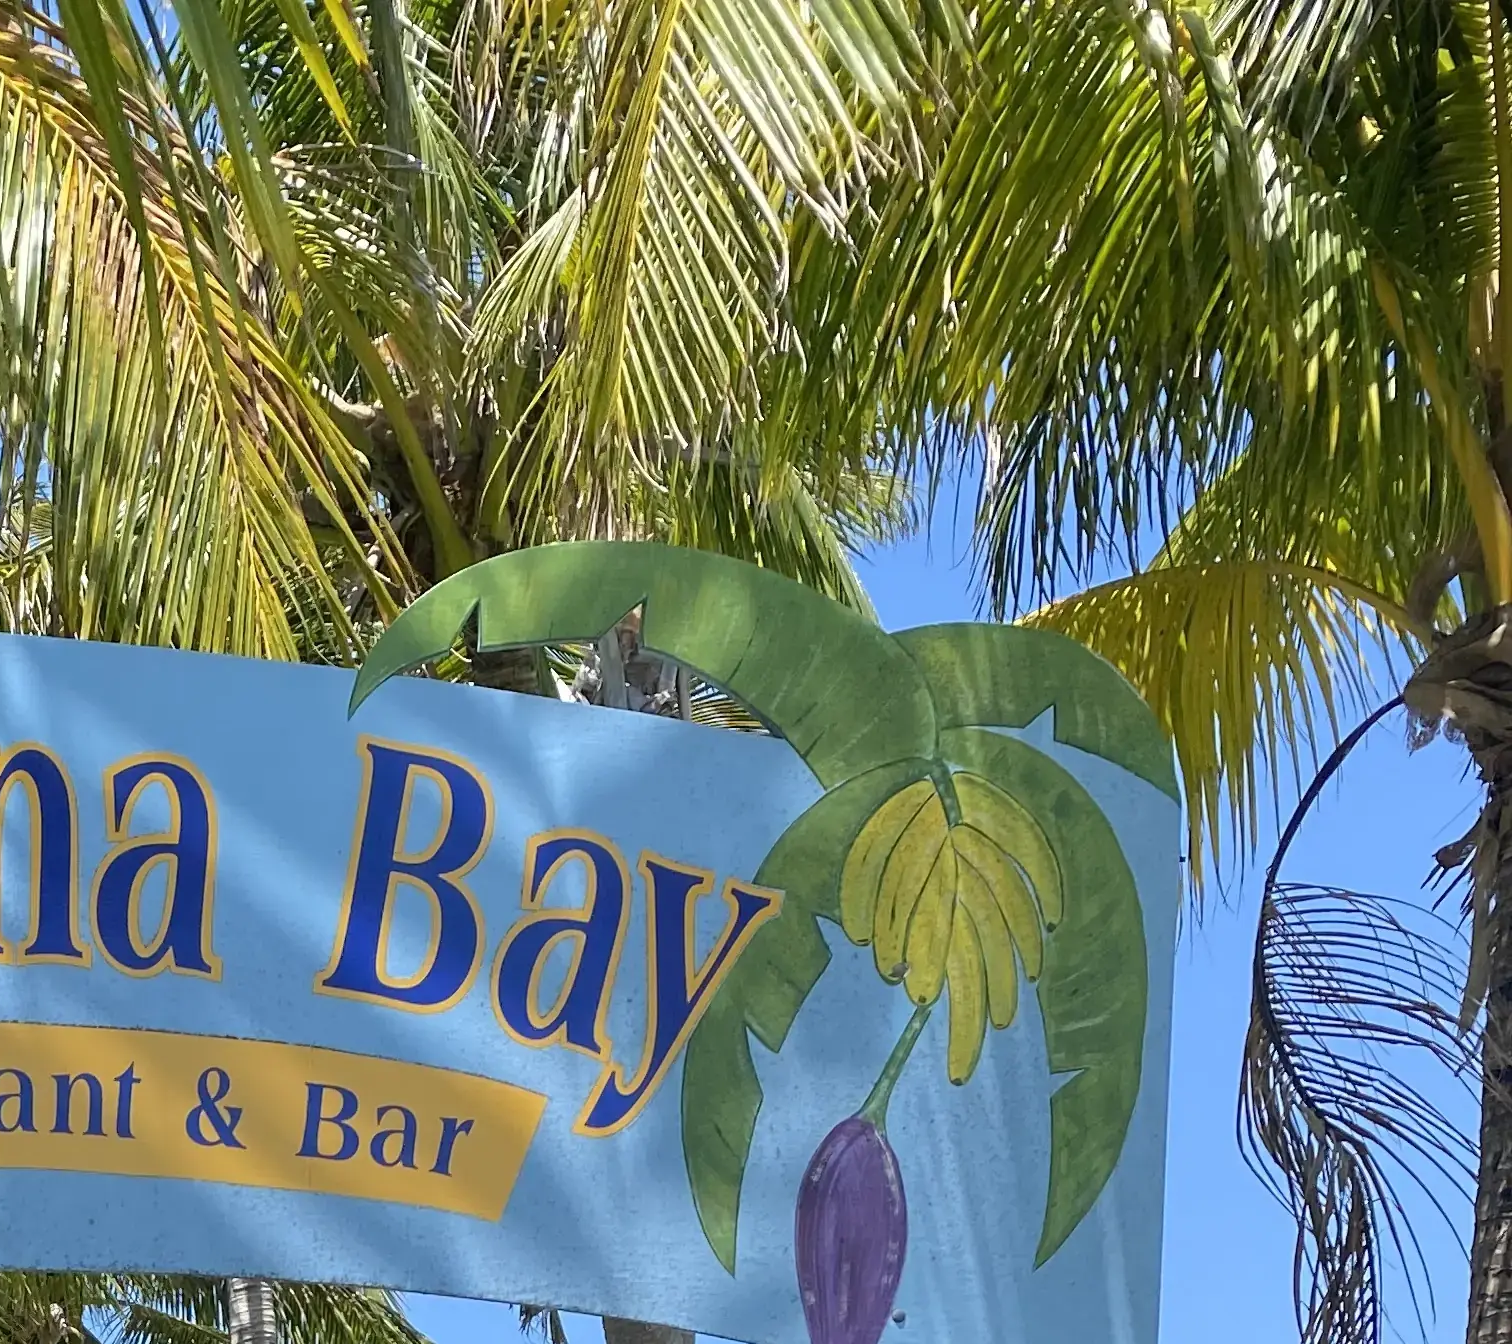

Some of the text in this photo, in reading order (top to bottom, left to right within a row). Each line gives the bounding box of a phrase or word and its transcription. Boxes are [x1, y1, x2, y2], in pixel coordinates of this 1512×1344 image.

[314, 733, 785, 1137] Bay
[185, 1067, 247, 1149] &
[296, 1080, 475, 1178] Bar
